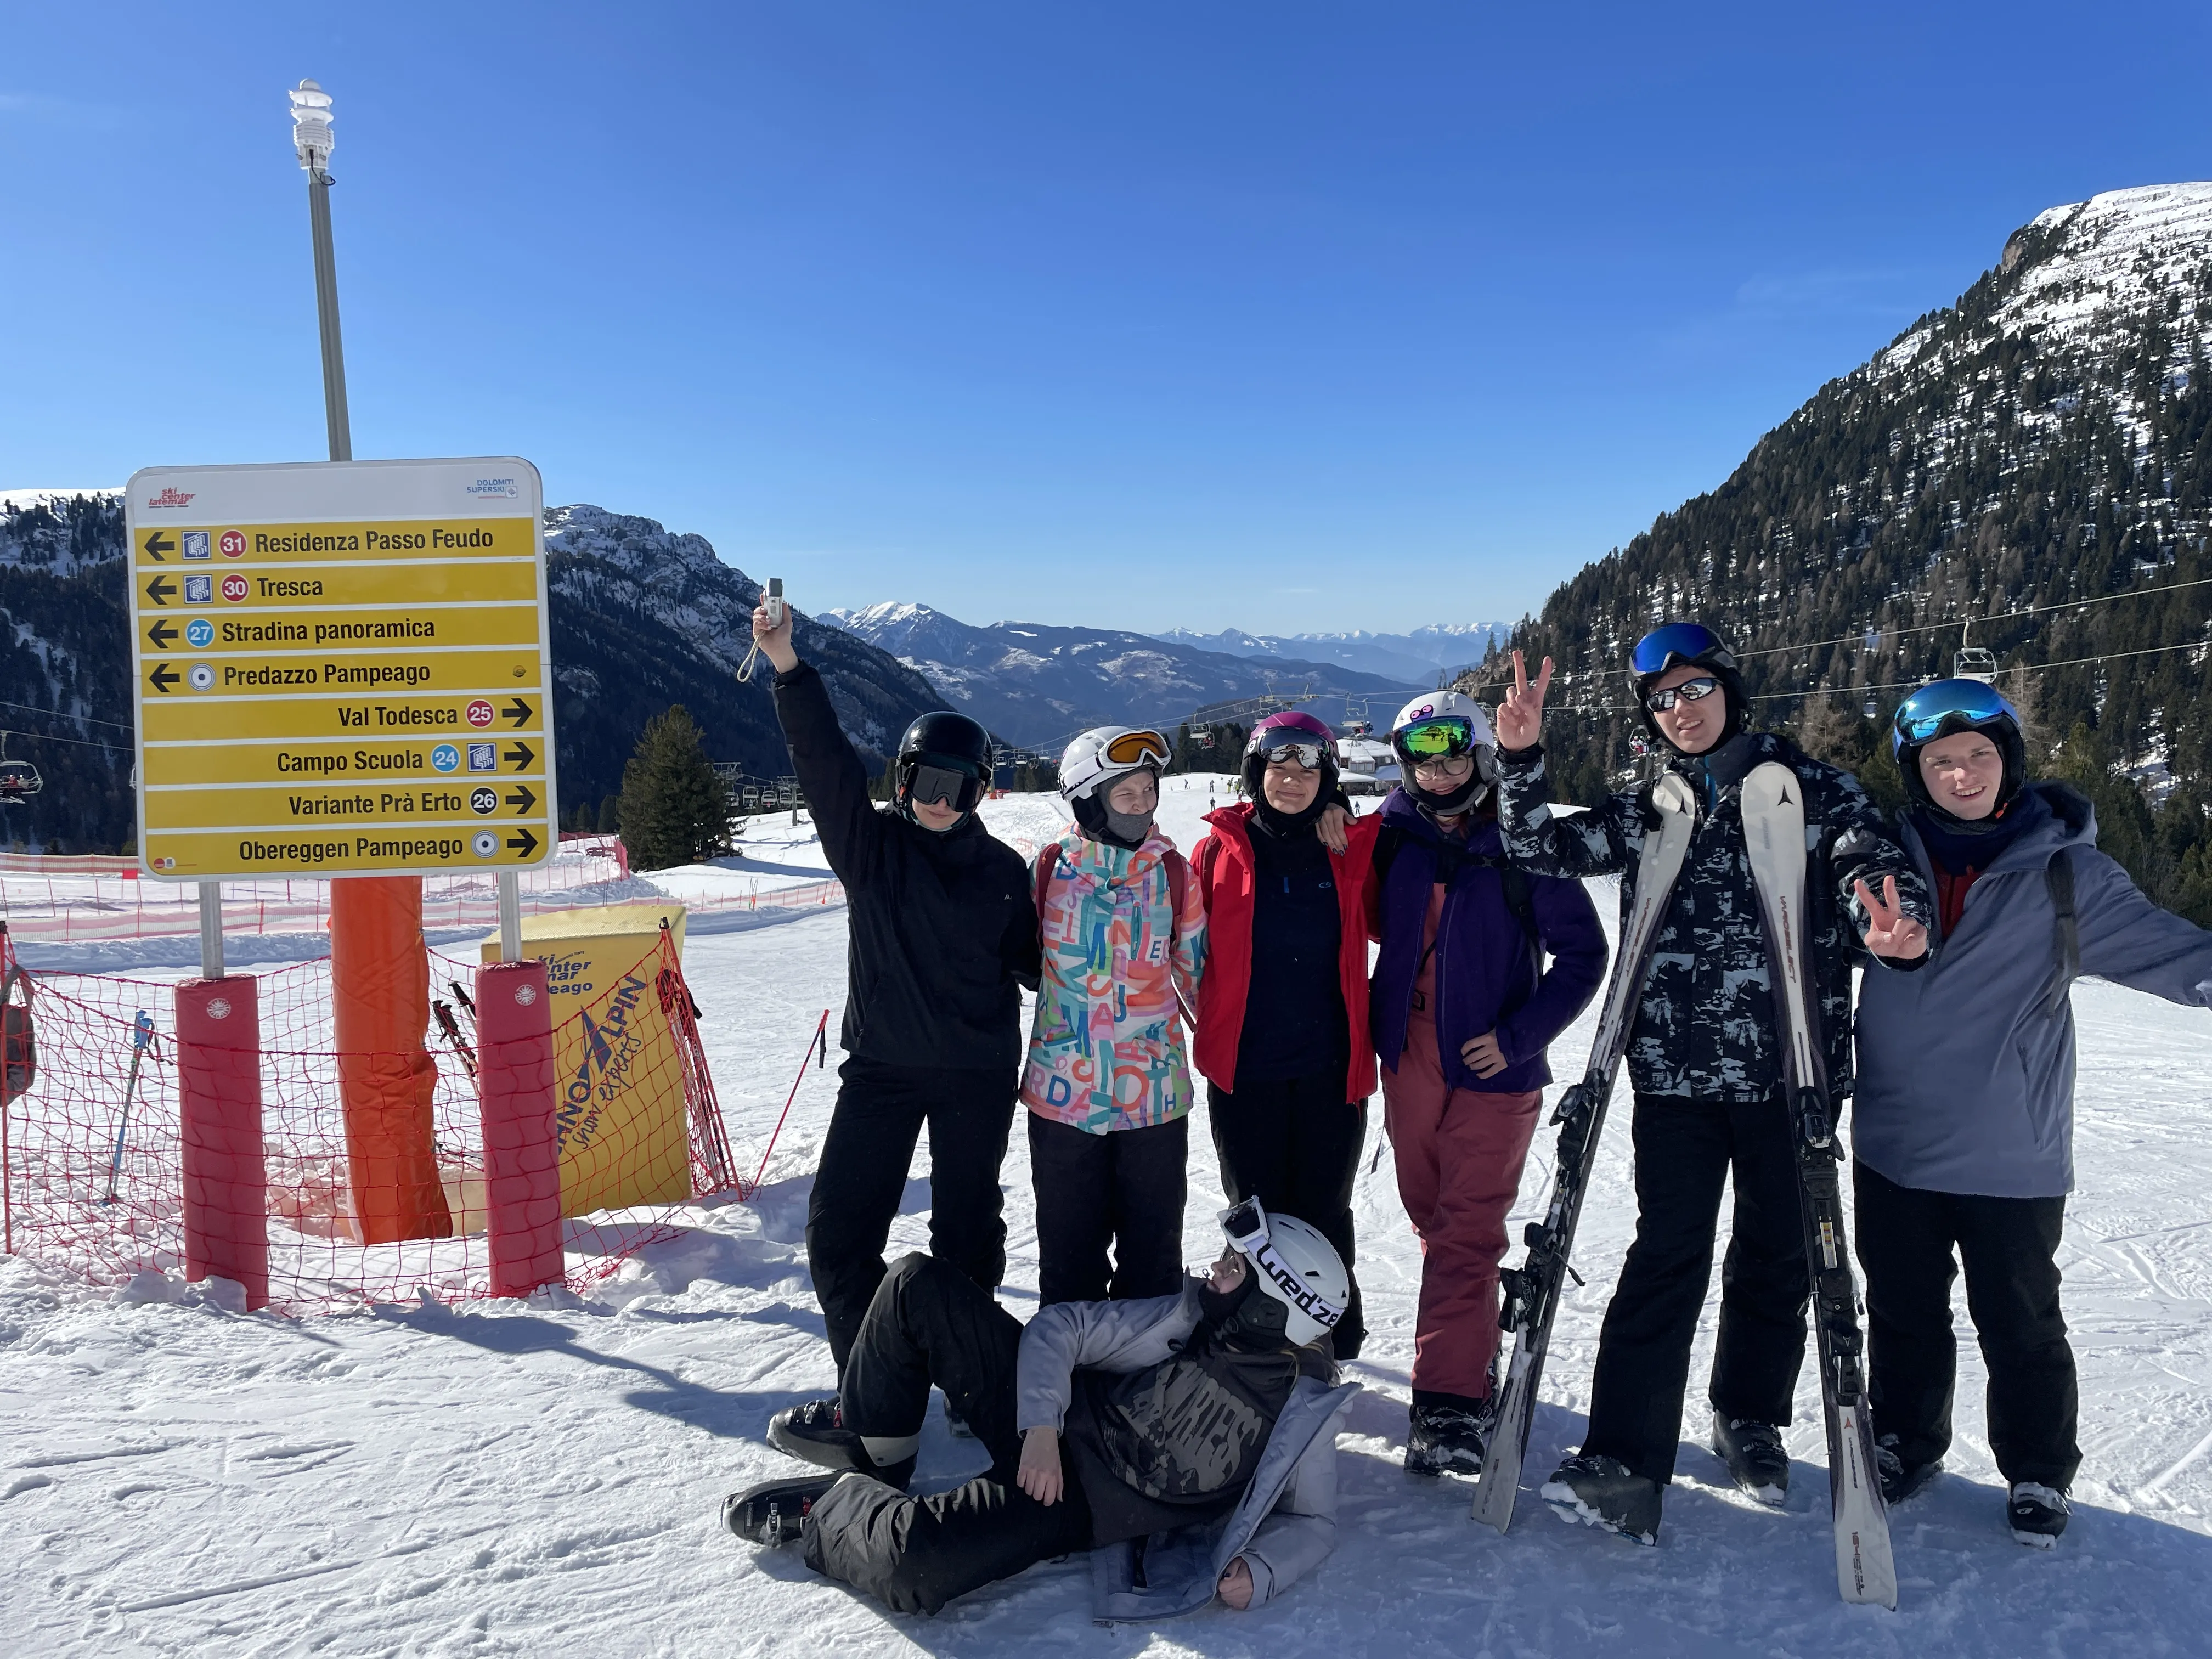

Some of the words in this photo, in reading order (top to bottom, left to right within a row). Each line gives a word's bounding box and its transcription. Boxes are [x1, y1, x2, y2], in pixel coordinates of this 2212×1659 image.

[223, 537, 242, 552] 31
[256, 532, 359, 552] Residenza
[366, 531, 426, 550] Passo
[433, 528, 493, 548] Feudo
[225, 581, 246, 596] 30
[256, 578, 323, 597] Tresca
[190, 626, 210, 640] 27
[222, 621, 308, 642] Stradina
[315, 618, 435, 644] panoramica
[224, 665, 317, 686] Predazzo
[324, 664, 430, 686] Pampeago
[338, 707, 369, 726] Val
[375, 706, 458, 725] Todesca
[470, 707, 491, 721] 25
[278, 753, 347, 775] Campo
[354, 749, 423, 770] Scuola
[436, 751, 456, 766] 24
[288, 795, 374, 815] Variante
[381, 792, 414, 812] Prà
[421, 793, 461, 811] Erto
[473, 793, 495, 808] 26
[240, 841, 349, 863] Obereggen
[357, 838, 462, 860] Pampeago
[538, 954, 555, 965] ki
[546, 961, 592, 973] nter
[546, 983, 593, 995] eago
[572, 1103, 602, 1150] snow
[599, 1032, 641, 1101] experts
